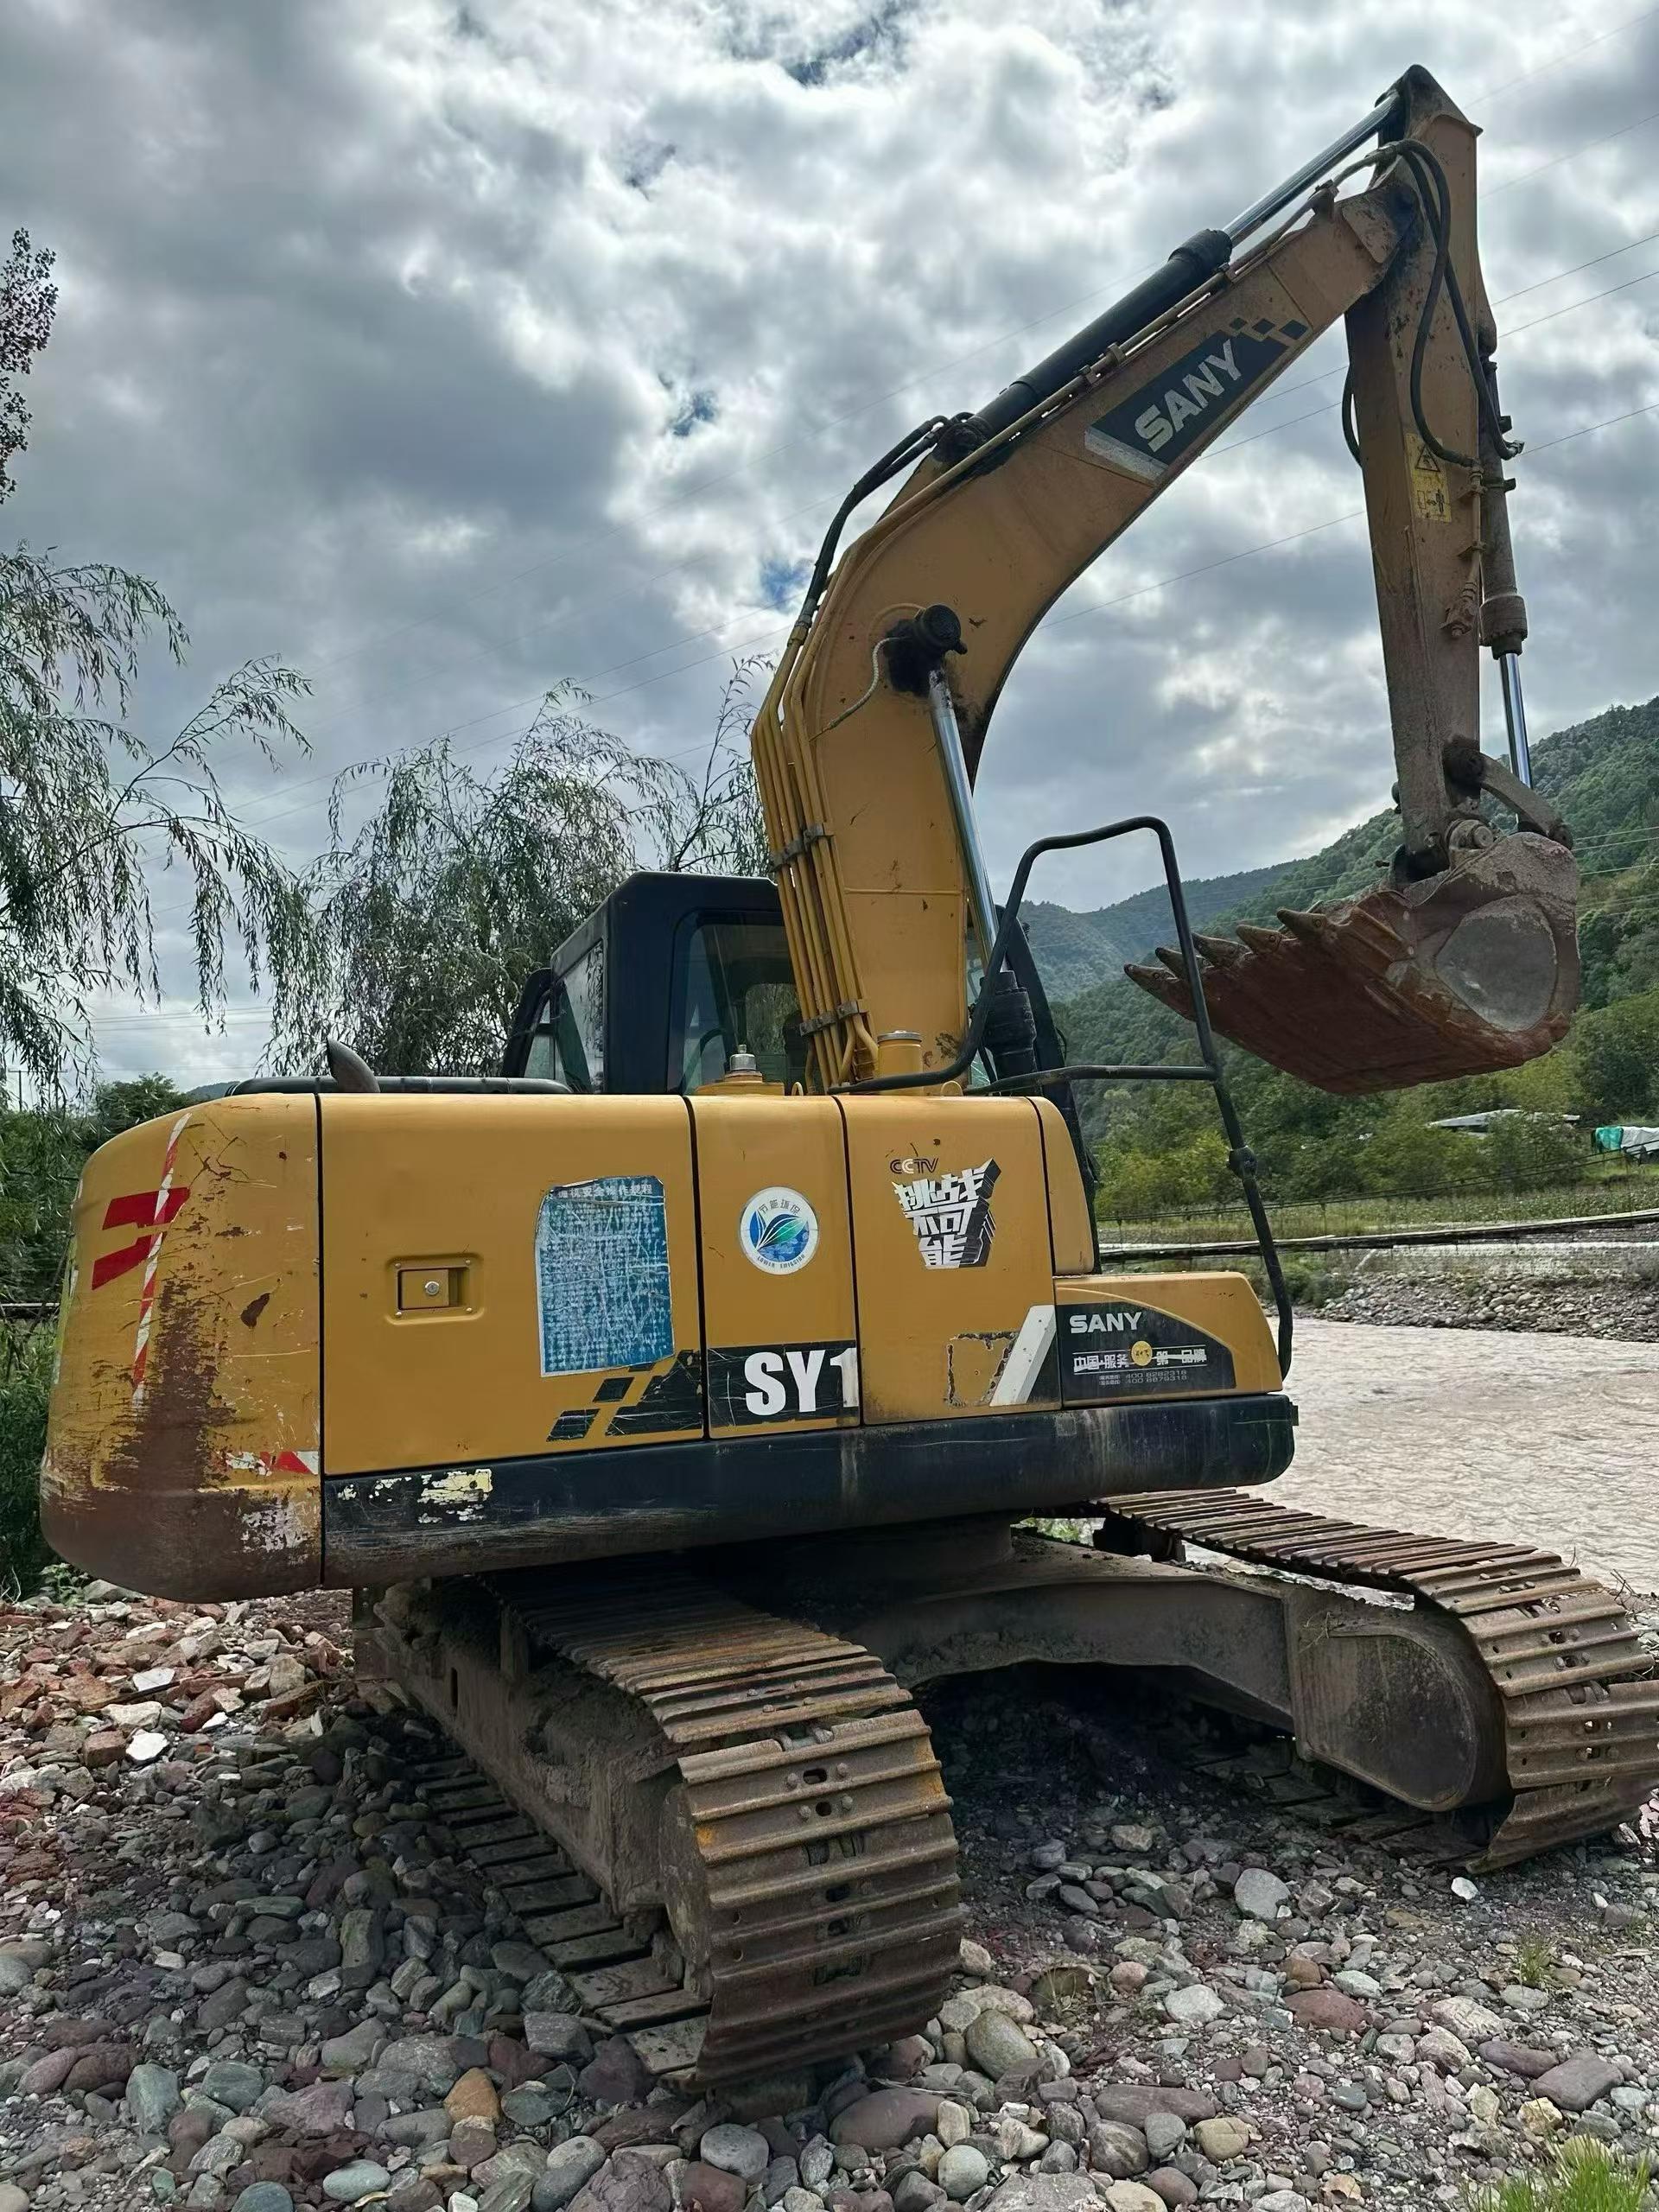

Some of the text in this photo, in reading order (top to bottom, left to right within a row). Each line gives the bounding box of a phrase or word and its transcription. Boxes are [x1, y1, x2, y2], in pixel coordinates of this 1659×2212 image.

[1135, 339, 1242, 453] SANY
[889, 1158, 939, 1174] CCTV
[892, 1159, 991, 1211] 挑战
[918, 1233, 969, 1269] 能
[1070, 1312, 1142, 1334] SANY
[744, 1347, 859, 1416] SY1
